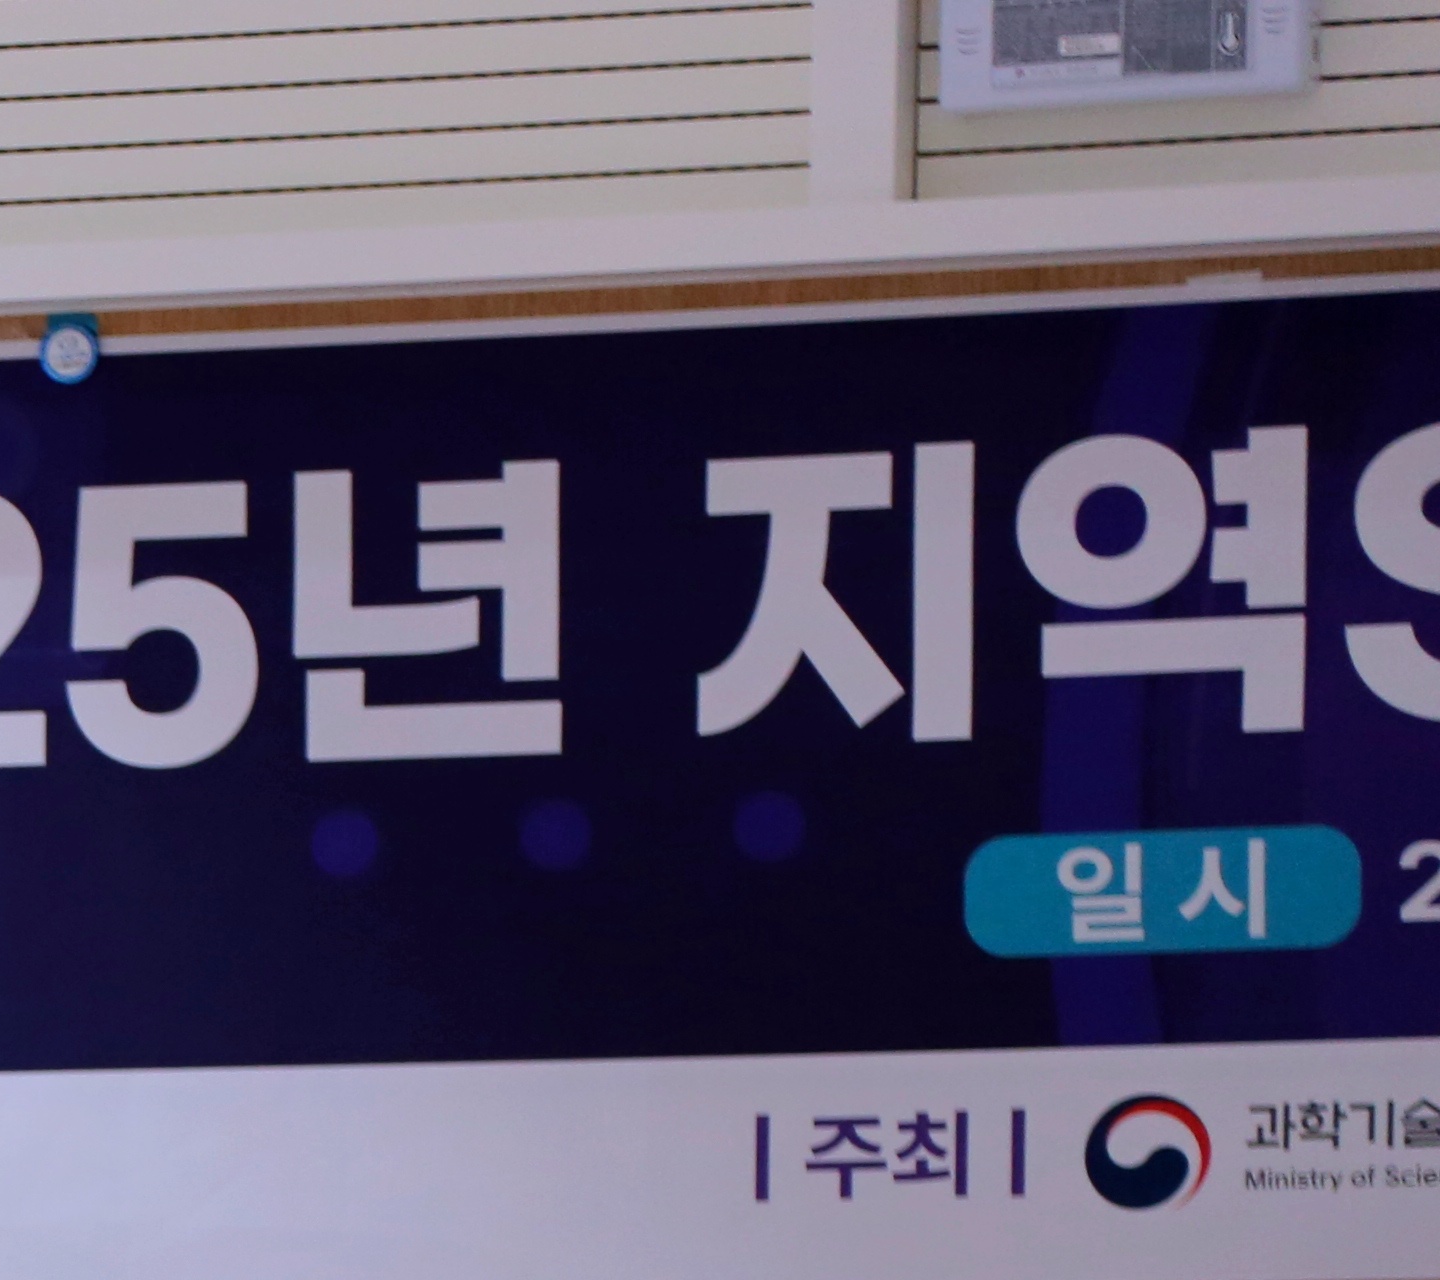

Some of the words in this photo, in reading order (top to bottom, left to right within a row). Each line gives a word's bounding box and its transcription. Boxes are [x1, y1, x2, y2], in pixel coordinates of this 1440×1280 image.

[1246, 1097, 1440, 1151] 과학기술
[805, 1110, 969, 1199] 주최
[1245, 1167, 1342, 1194] Ministry
[1351, 1164, 1374, 1188] of
[1384, 1164, 1440, 1188] Scie
